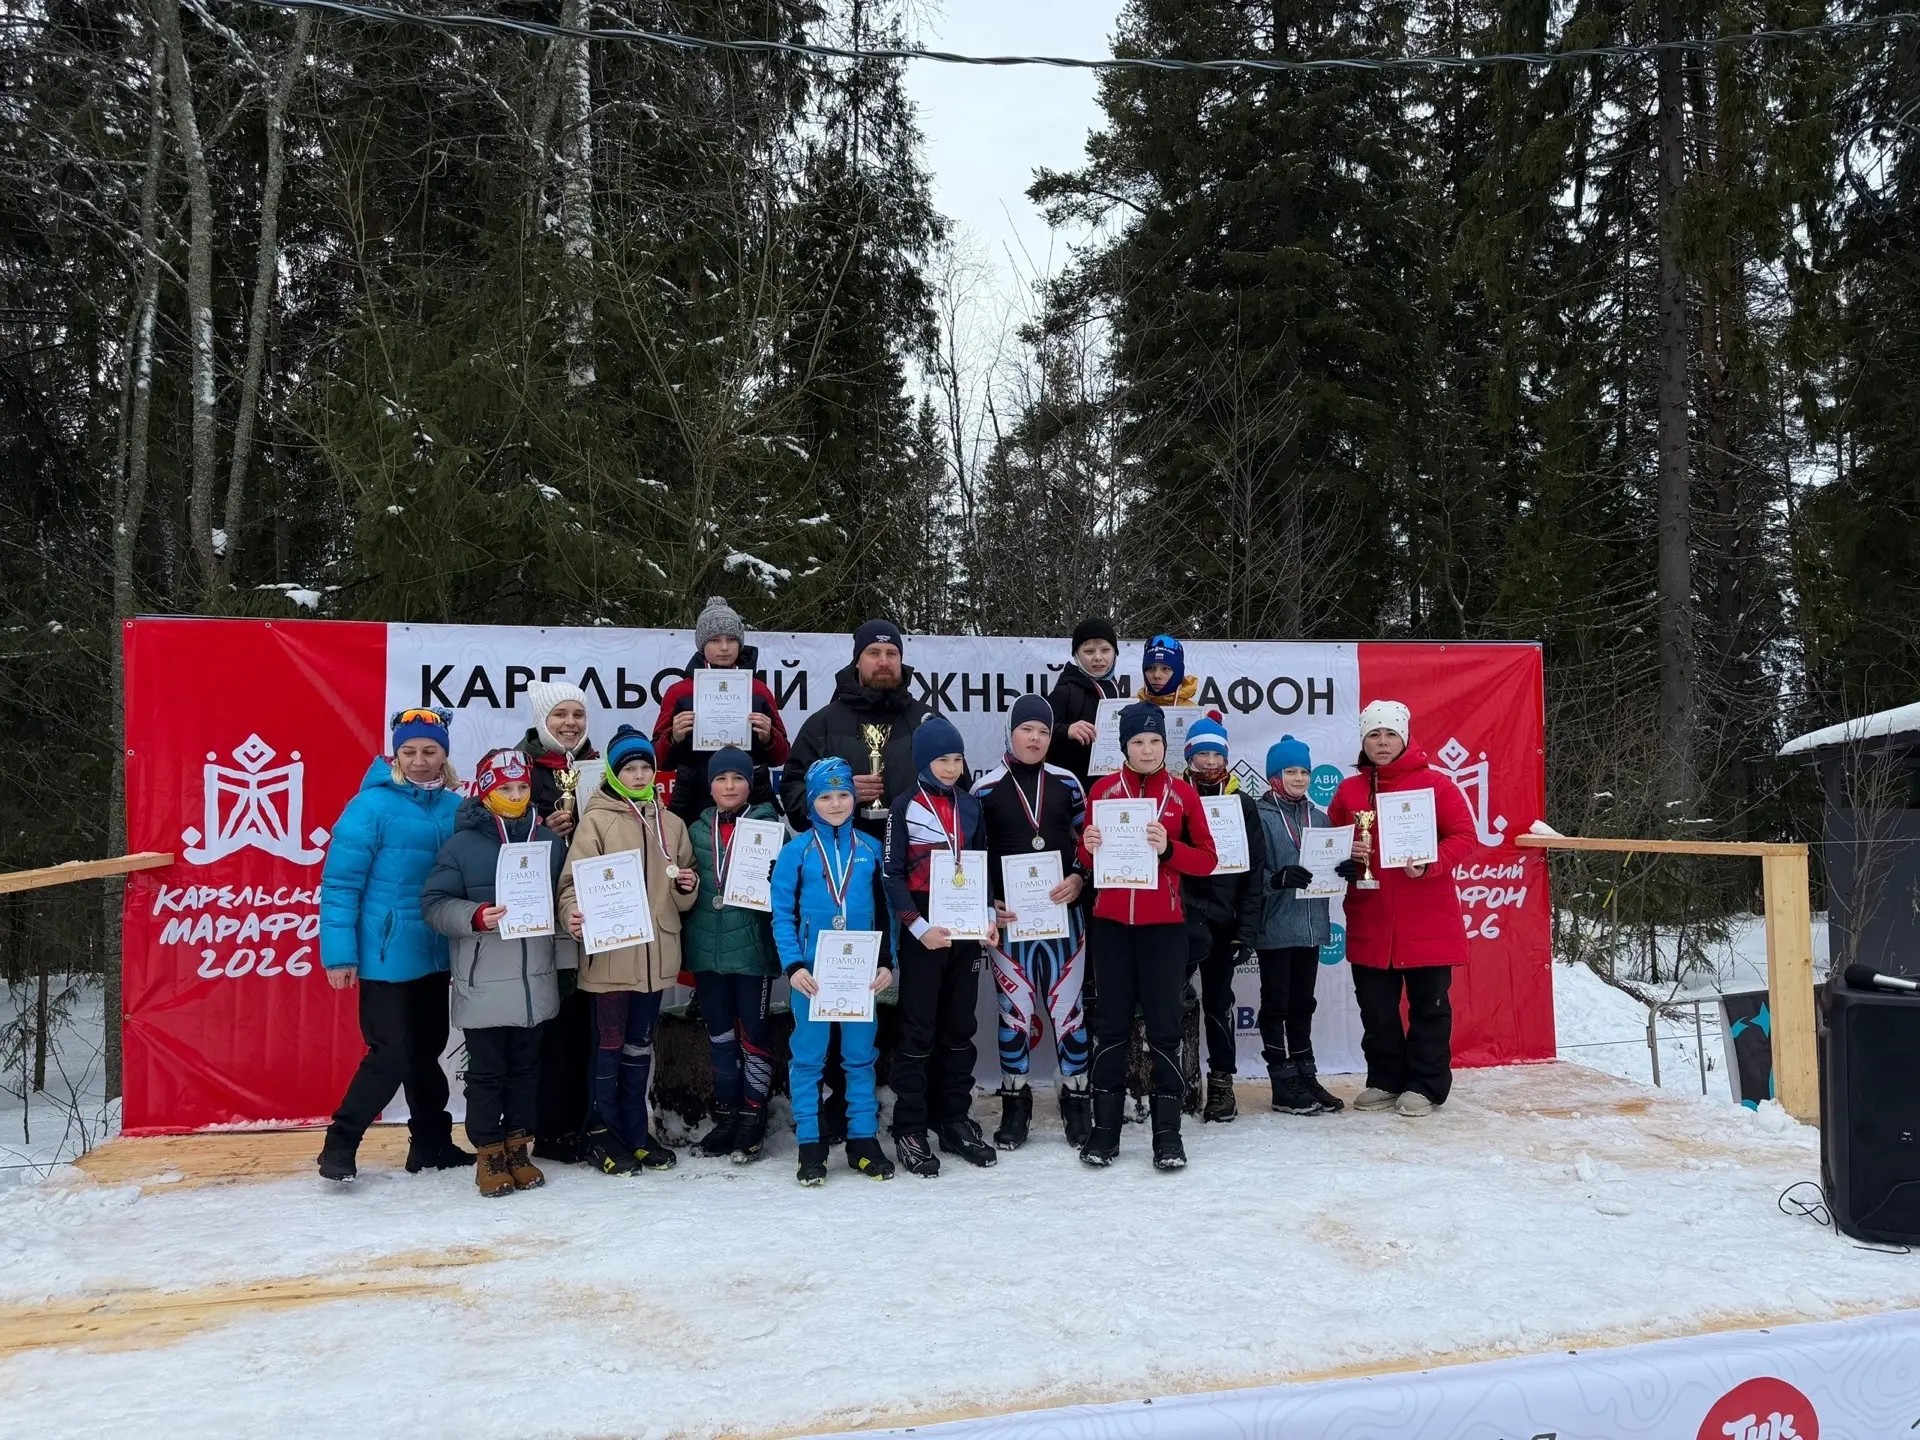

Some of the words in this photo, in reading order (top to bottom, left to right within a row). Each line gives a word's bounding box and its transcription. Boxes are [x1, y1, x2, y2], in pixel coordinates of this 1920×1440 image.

[704, 693, 741, 701] ГРАМОТА
[1314, 775, 1338, 784] АВИ
[1389, 812, 1425, 822] ГРАМОТА
[1104, 825, 1145, 833] ГРАМОТА
[884, 813, 893, 863] NORDSKI
[741, 845, 772, 856] ГРАМОТА
[1310, 848, 1344, 858] ГРАМОТА
[506, 871, 541, 880] ГРАМОТА
[588, 880, 632, 895] ГРАМОТА
[1014, 879, 1053, 889] ГРАМОТА
[159, 912, 321, 946] МАРАФО
[197, 947, 312, 978] 2026
[826, 957, 866, 965] ГРАМОТА
